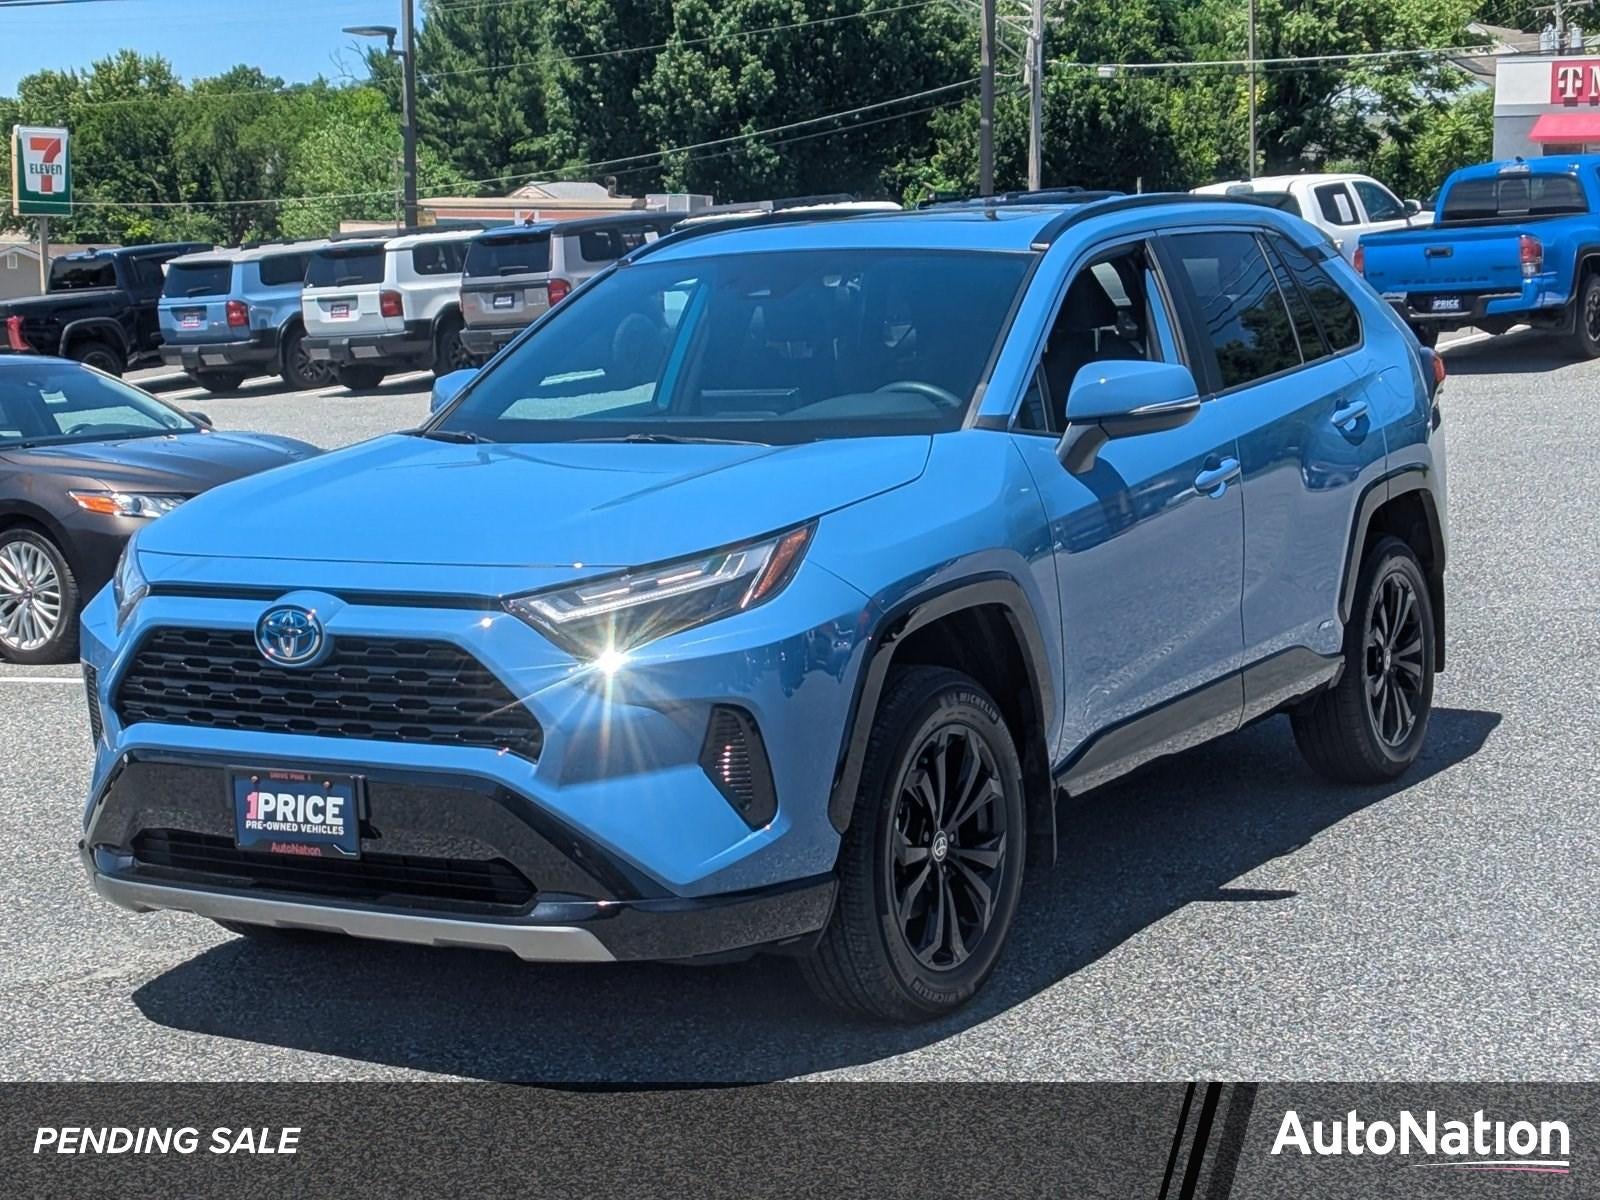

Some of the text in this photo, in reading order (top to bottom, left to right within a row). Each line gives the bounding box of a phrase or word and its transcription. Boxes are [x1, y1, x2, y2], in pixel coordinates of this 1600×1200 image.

[30, 137, 61, 192] 7
[245, 820, 344, 835] PRE-OWNED VEHICLES
[271, 842, 321, 856] AutoNation
